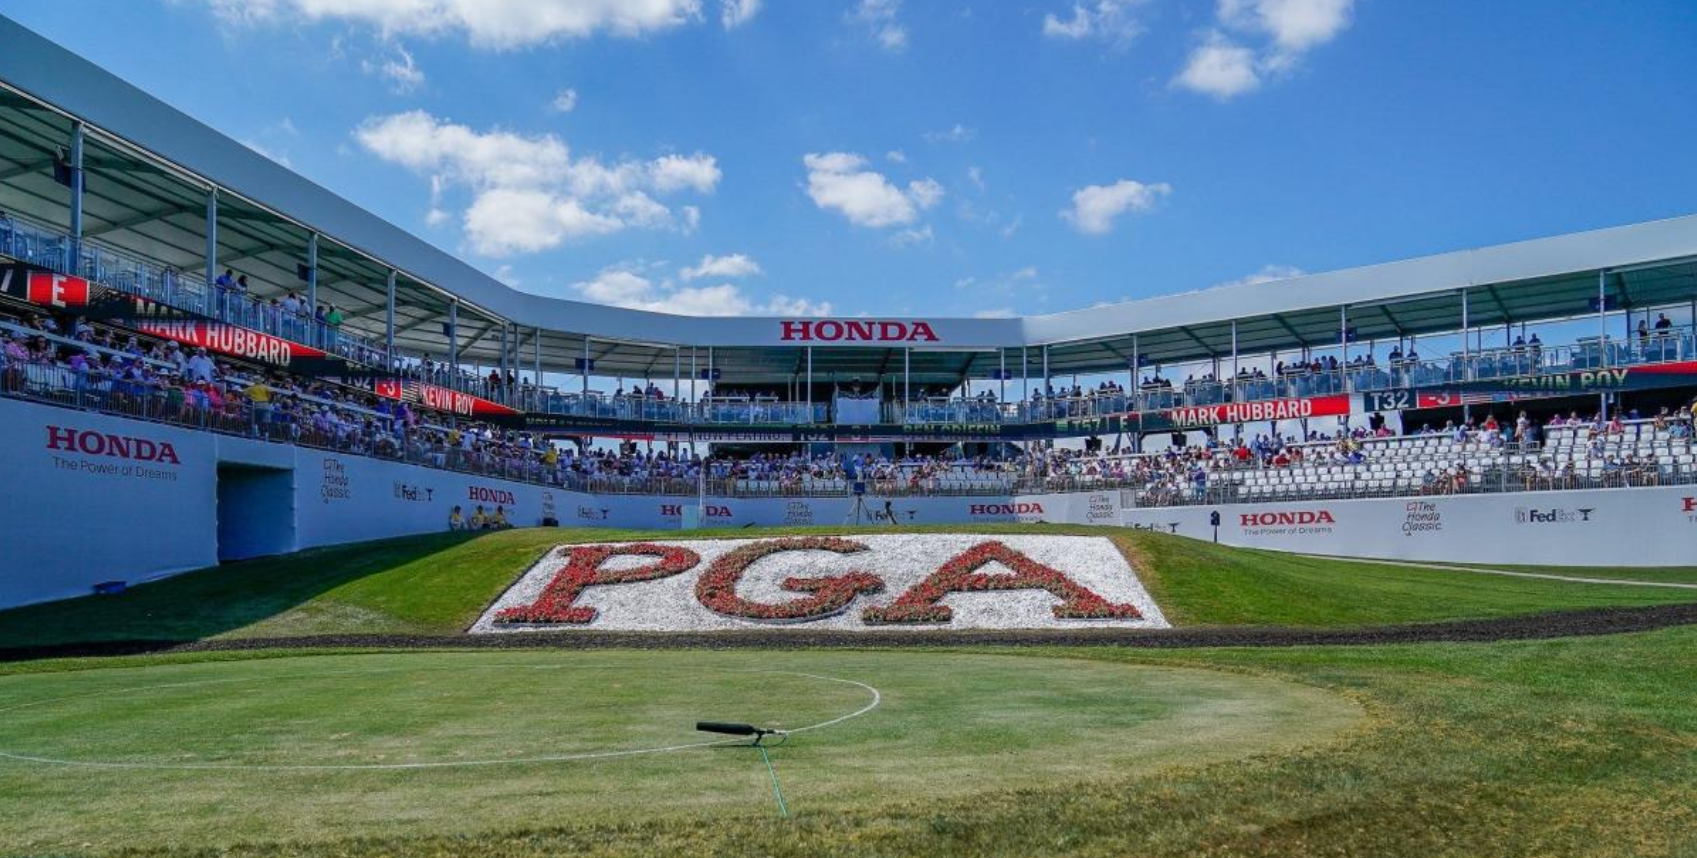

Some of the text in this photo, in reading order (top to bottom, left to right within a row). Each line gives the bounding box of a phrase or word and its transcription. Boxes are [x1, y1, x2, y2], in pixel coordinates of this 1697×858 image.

[52, 273, 66, 307] E
[780, 320, 939, 341] HONDA
[205, 322, 290, 367] HUBBARD
[422, 384, 475, 416] KEVIN ROY
[1370, 390, 1409, 411] T32
[1172, 400, 1312, 427] MARK HUBBARD
[46, 425, 181, 465] HONDA
[52, 456, 78, 470] The
[81, 460, 118, 474] Power
[136, 466, 178, 481] Dreams
[469, 486, 516, 505] HONDA
[1417, 501, 1436, 511] The
[661, 504, 734, 517] HDA
[970, 503, 1044, 515] HONDA
[1239, 510, 1336, 526] HONDA
[1406, 511, 1441, 521] Honda
[1244, 528, 1258, 536] The
[1298, 526, 1333, 535] Dreams
[1402, 521, 1443, 532] Classic
[493, 537, 1144, 623] PGA
